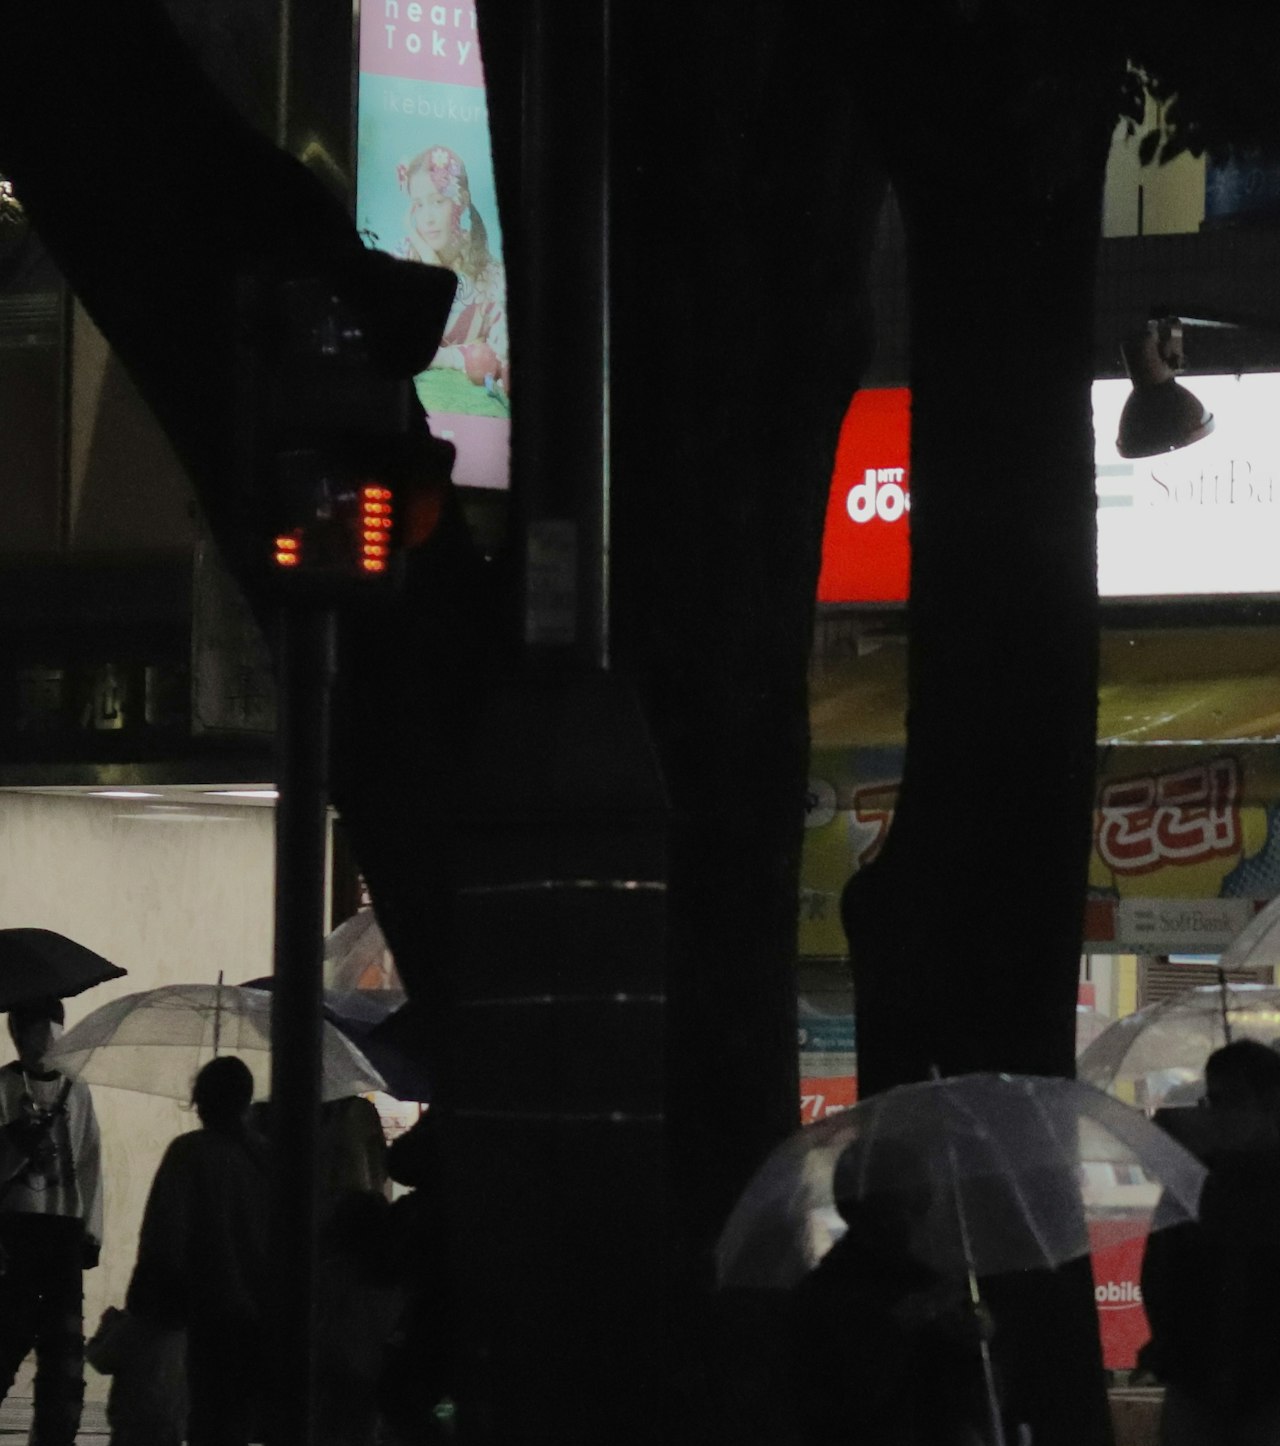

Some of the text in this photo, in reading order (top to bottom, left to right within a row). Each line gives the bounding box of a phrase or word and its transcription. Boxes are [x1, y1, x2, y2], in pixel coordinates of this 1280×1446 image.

[383, 89, 487, 123] ikebukur
[877, 467, 905, 482] NTT
[847, 469, 911, 523] do
[1094, 1280, 1143, 1302] obile
